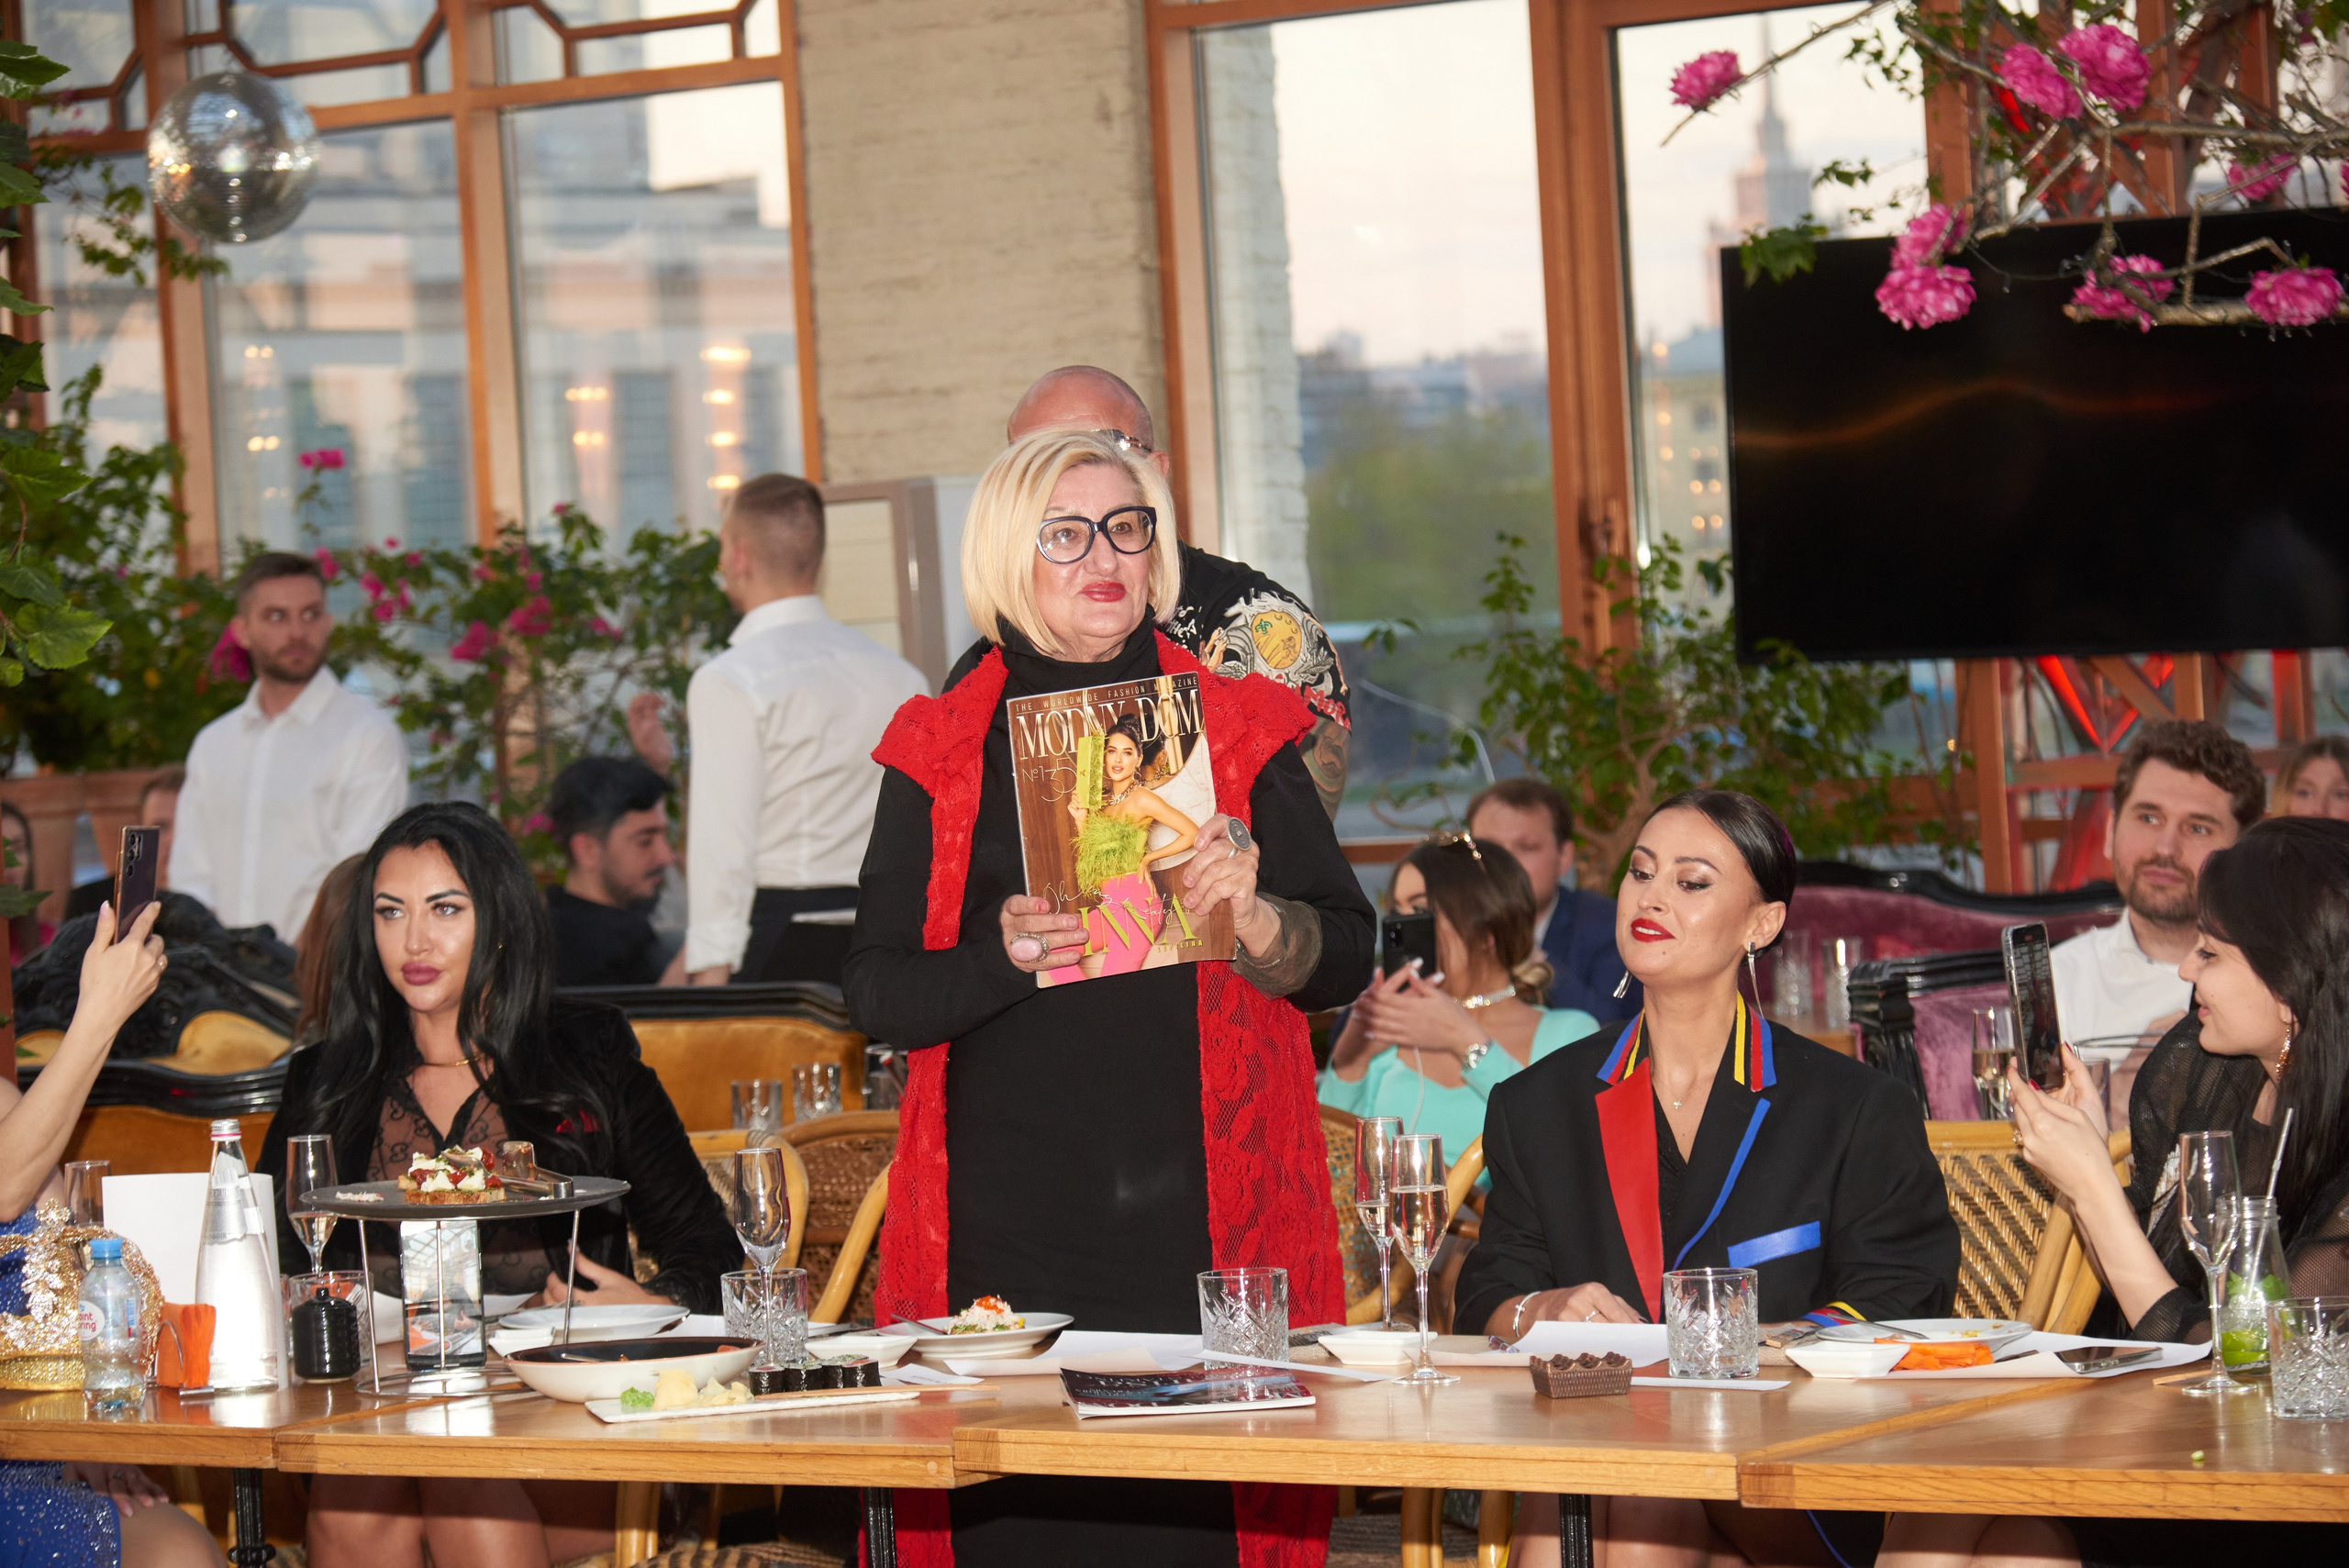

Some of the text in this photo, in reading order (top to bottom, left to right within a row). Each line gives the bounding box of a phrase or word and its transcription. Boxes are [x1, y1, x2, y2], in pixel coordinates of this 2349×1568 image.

[1015, 678, 1197, 713] THE WORLDWDE FASHION MAZINE
[1135, 688, 1204, 743] DOM
[1077, 892, 1201, 957] INNA
